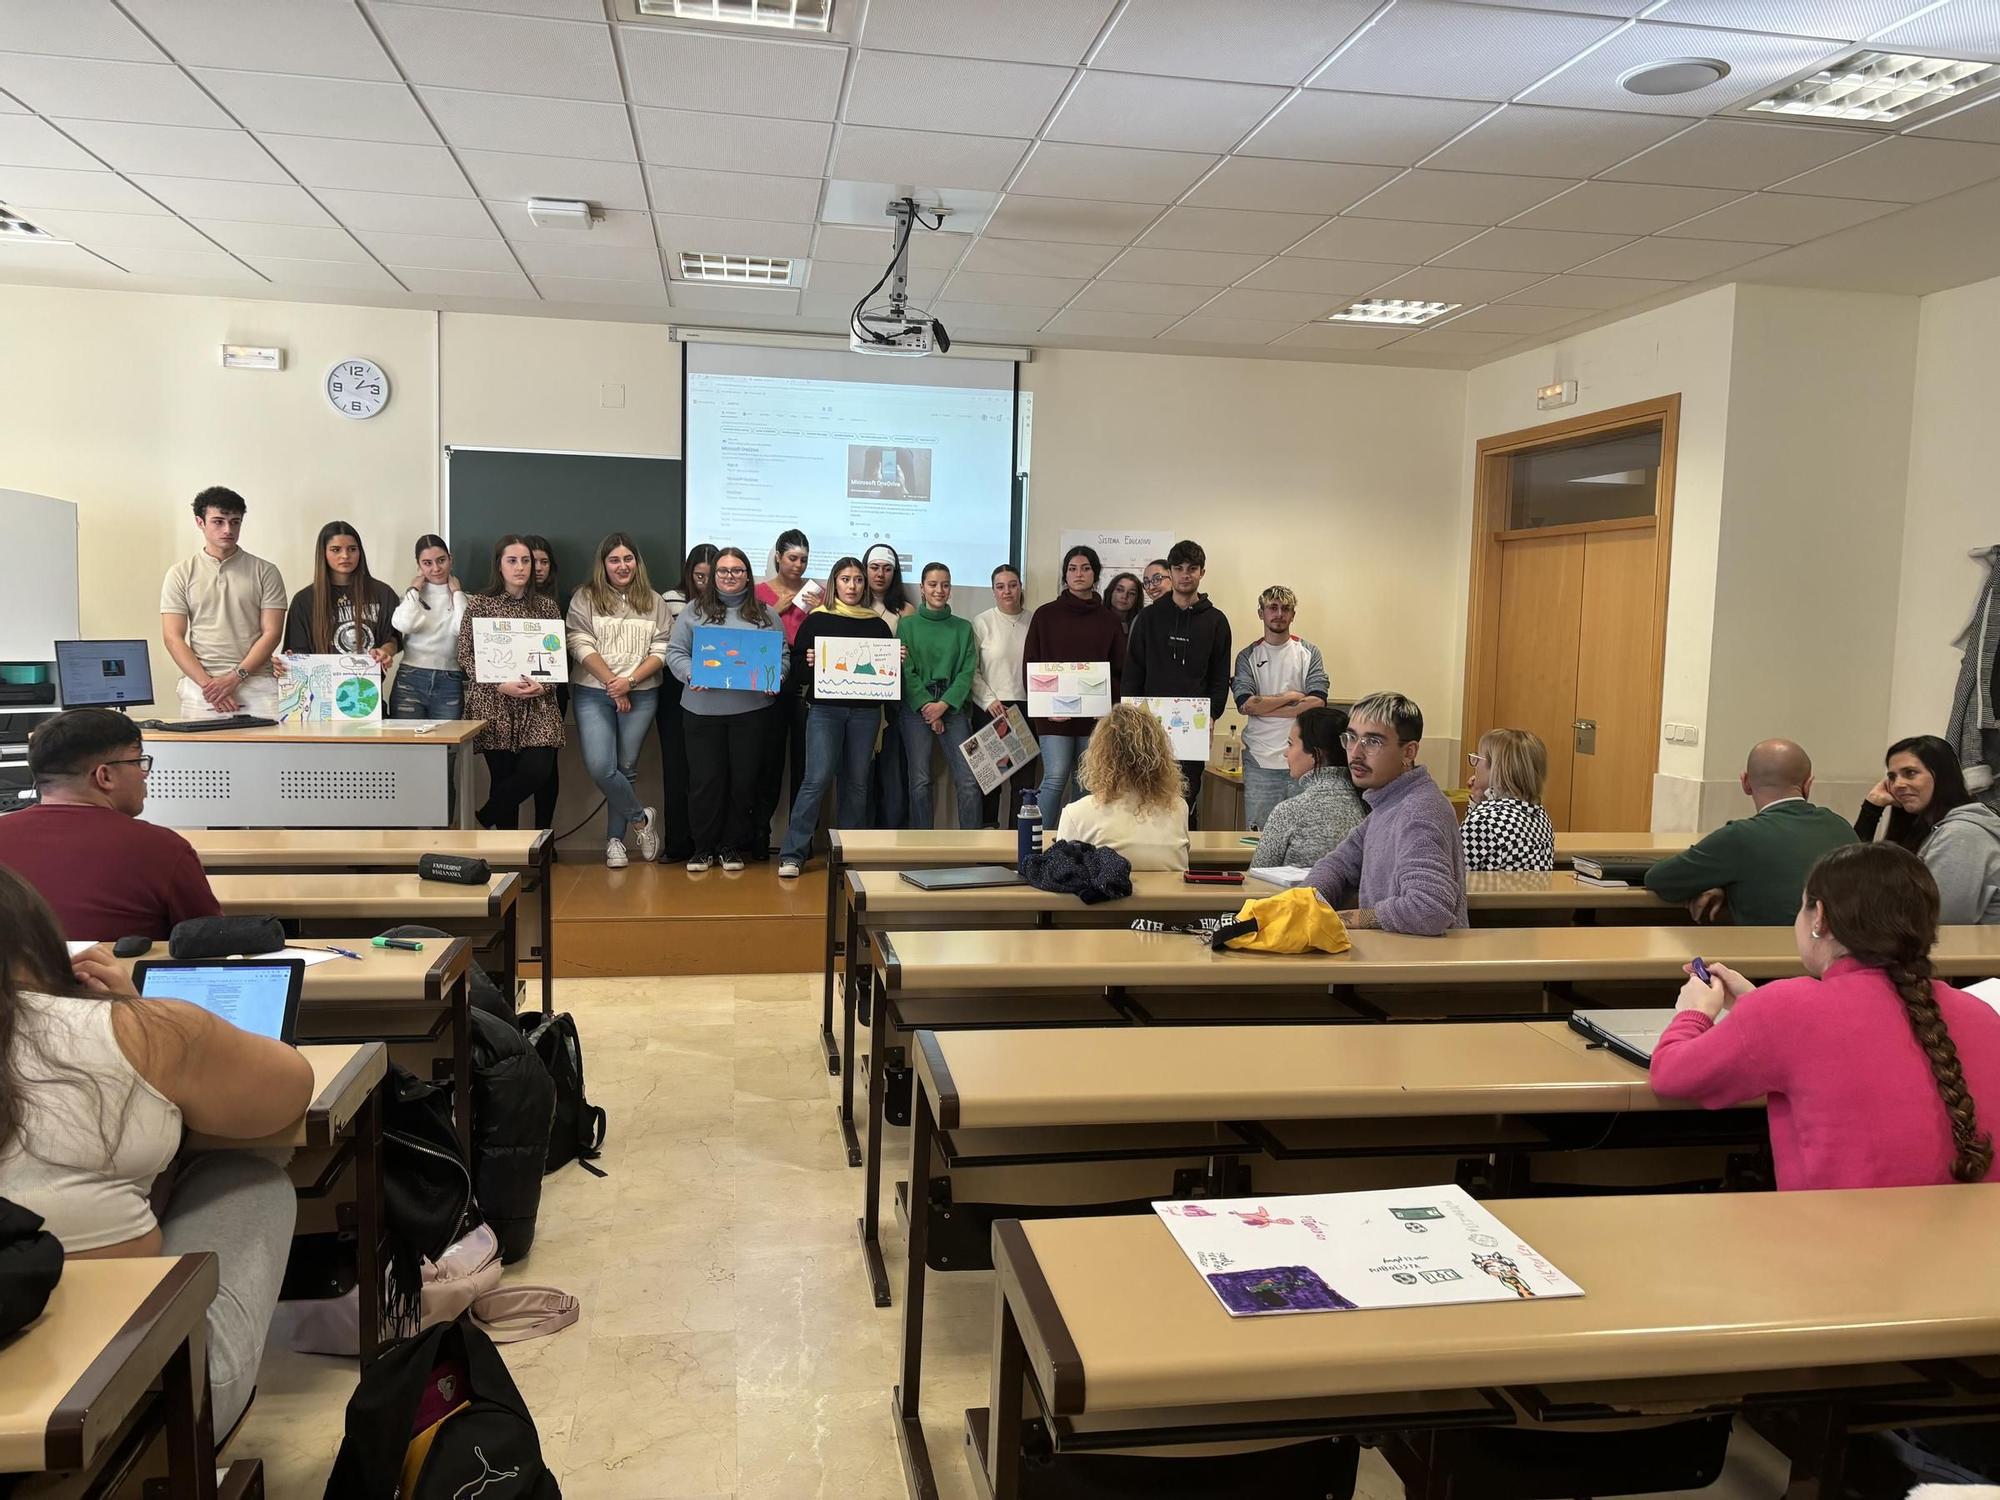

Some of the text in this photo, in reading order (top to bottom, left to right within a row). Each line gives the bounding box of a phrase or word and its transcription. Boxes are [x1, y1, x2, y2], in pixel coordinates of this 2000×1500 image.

[350, 366, 363, 376] 12
[333, 382, 342, 392] 9
[370, 384, 380, 395] 3
[352, 401, 361, 411] 6
